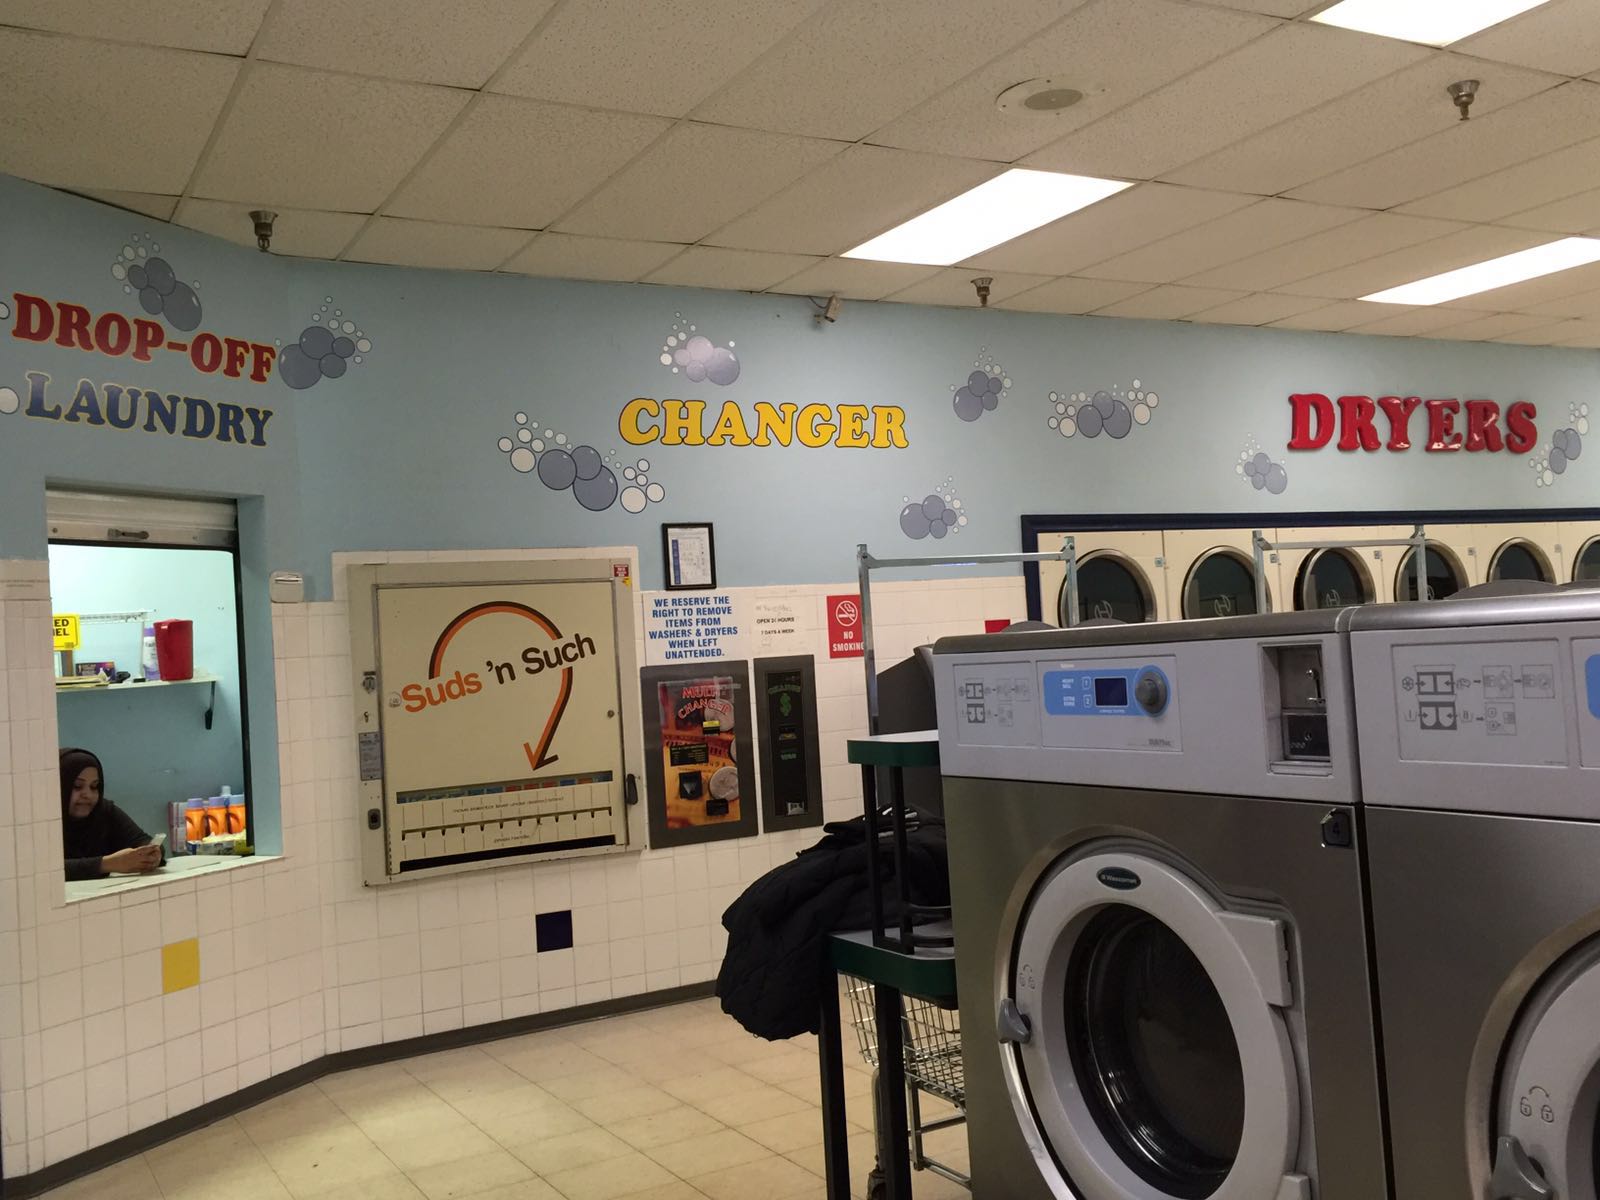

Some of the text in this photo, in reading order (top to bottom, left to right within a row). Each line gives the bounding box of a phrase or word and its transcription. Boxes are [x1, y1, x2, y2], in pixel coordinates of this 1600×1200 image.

[12, 293, 277, 382] DROP-OFF
[25, 370, 273, 446] LAUNDRY
[618, 398, 909, 448] CHANGER
[1287, 393, 1538, 454] DRYERS
[654, 596, 730, 607] WE RESERVE THE
[652, 606, 732, 618] RIGHT TO REMOVE
[665, 617, 721, 628] ITEMS FROM
[649, 626, 738, 639] WASHERS & DRYERS
[843, 631, 854, 639] NO
[668, 638, 718, 648] WHEN LEFT
[665, 648, 725, 659] UNATTENDED.
[401, 670, 483, 713] Suds
[521, 633, 597, 675] Such
